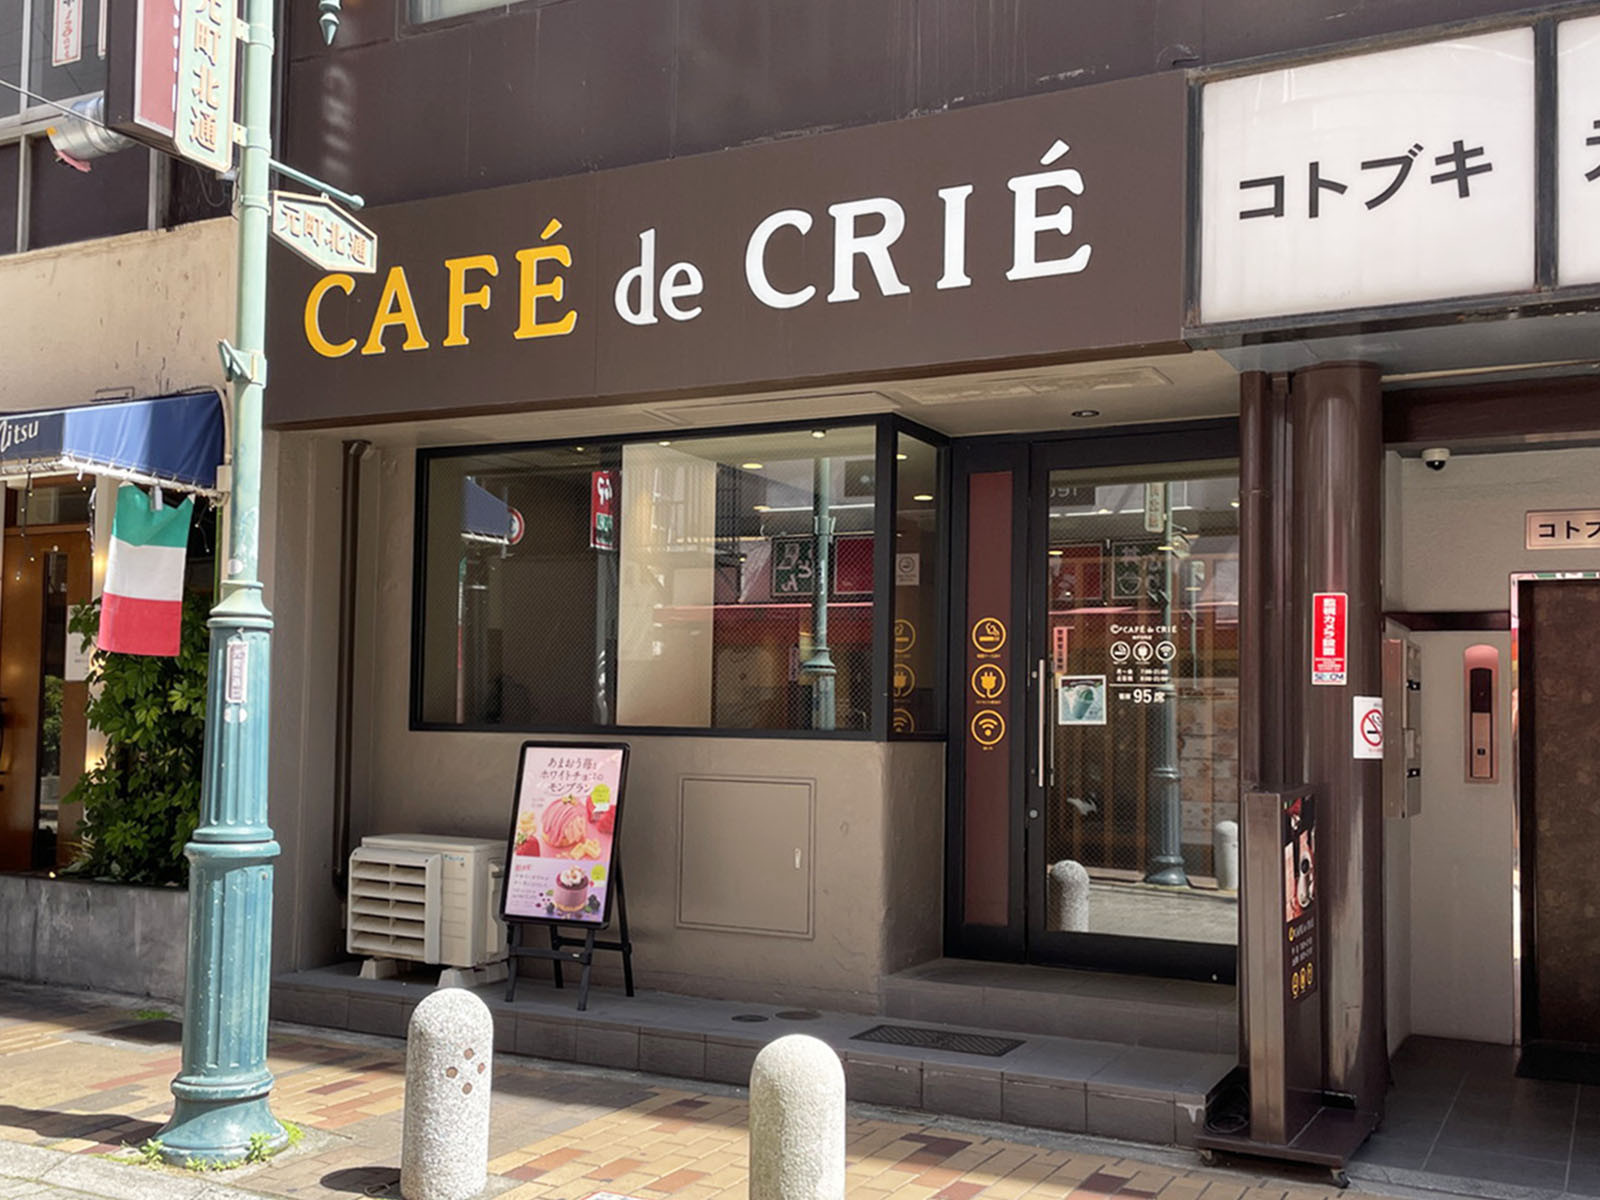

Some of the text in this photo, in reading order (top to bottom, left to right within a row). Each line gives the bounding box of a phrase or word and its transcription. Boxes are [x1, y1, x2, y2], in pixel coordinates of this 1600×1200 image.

[303, 138, 1093, 359] CAFÉ de CRIÉ
[1238, 138, 1494, 221] コトブキ
